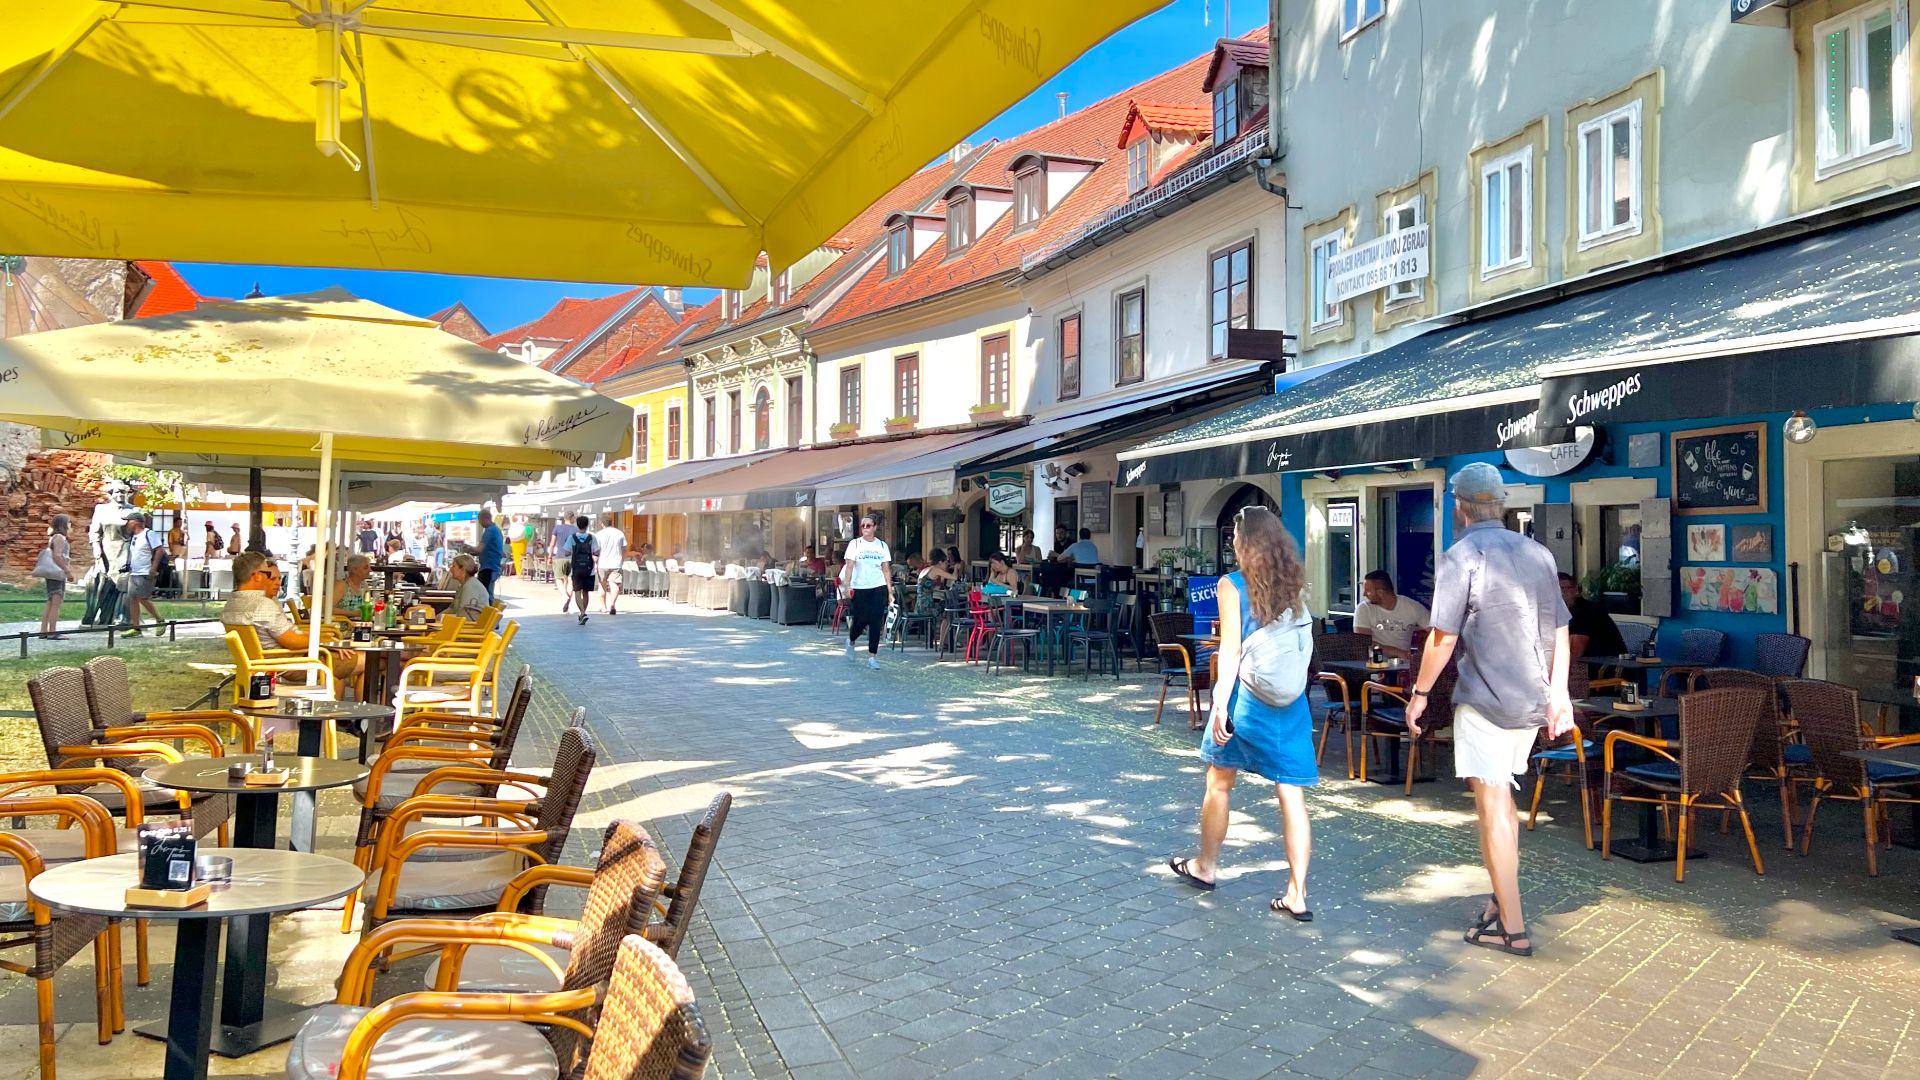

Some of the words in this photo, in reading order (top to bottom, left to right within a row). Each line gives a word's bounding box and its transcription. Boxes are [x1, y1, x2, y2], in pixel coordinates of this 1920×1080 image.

[1336, 273, 1366, 297] KONTAKT
[1400, 257, 1418, 275] 813
[1566, 372, 1641, 425] Schweppes
[1550, 445, 1580, 460] CAFFE
[1332, 512, 1351, 523] ATM
[1190, 587, 1219, 603] EXCH
